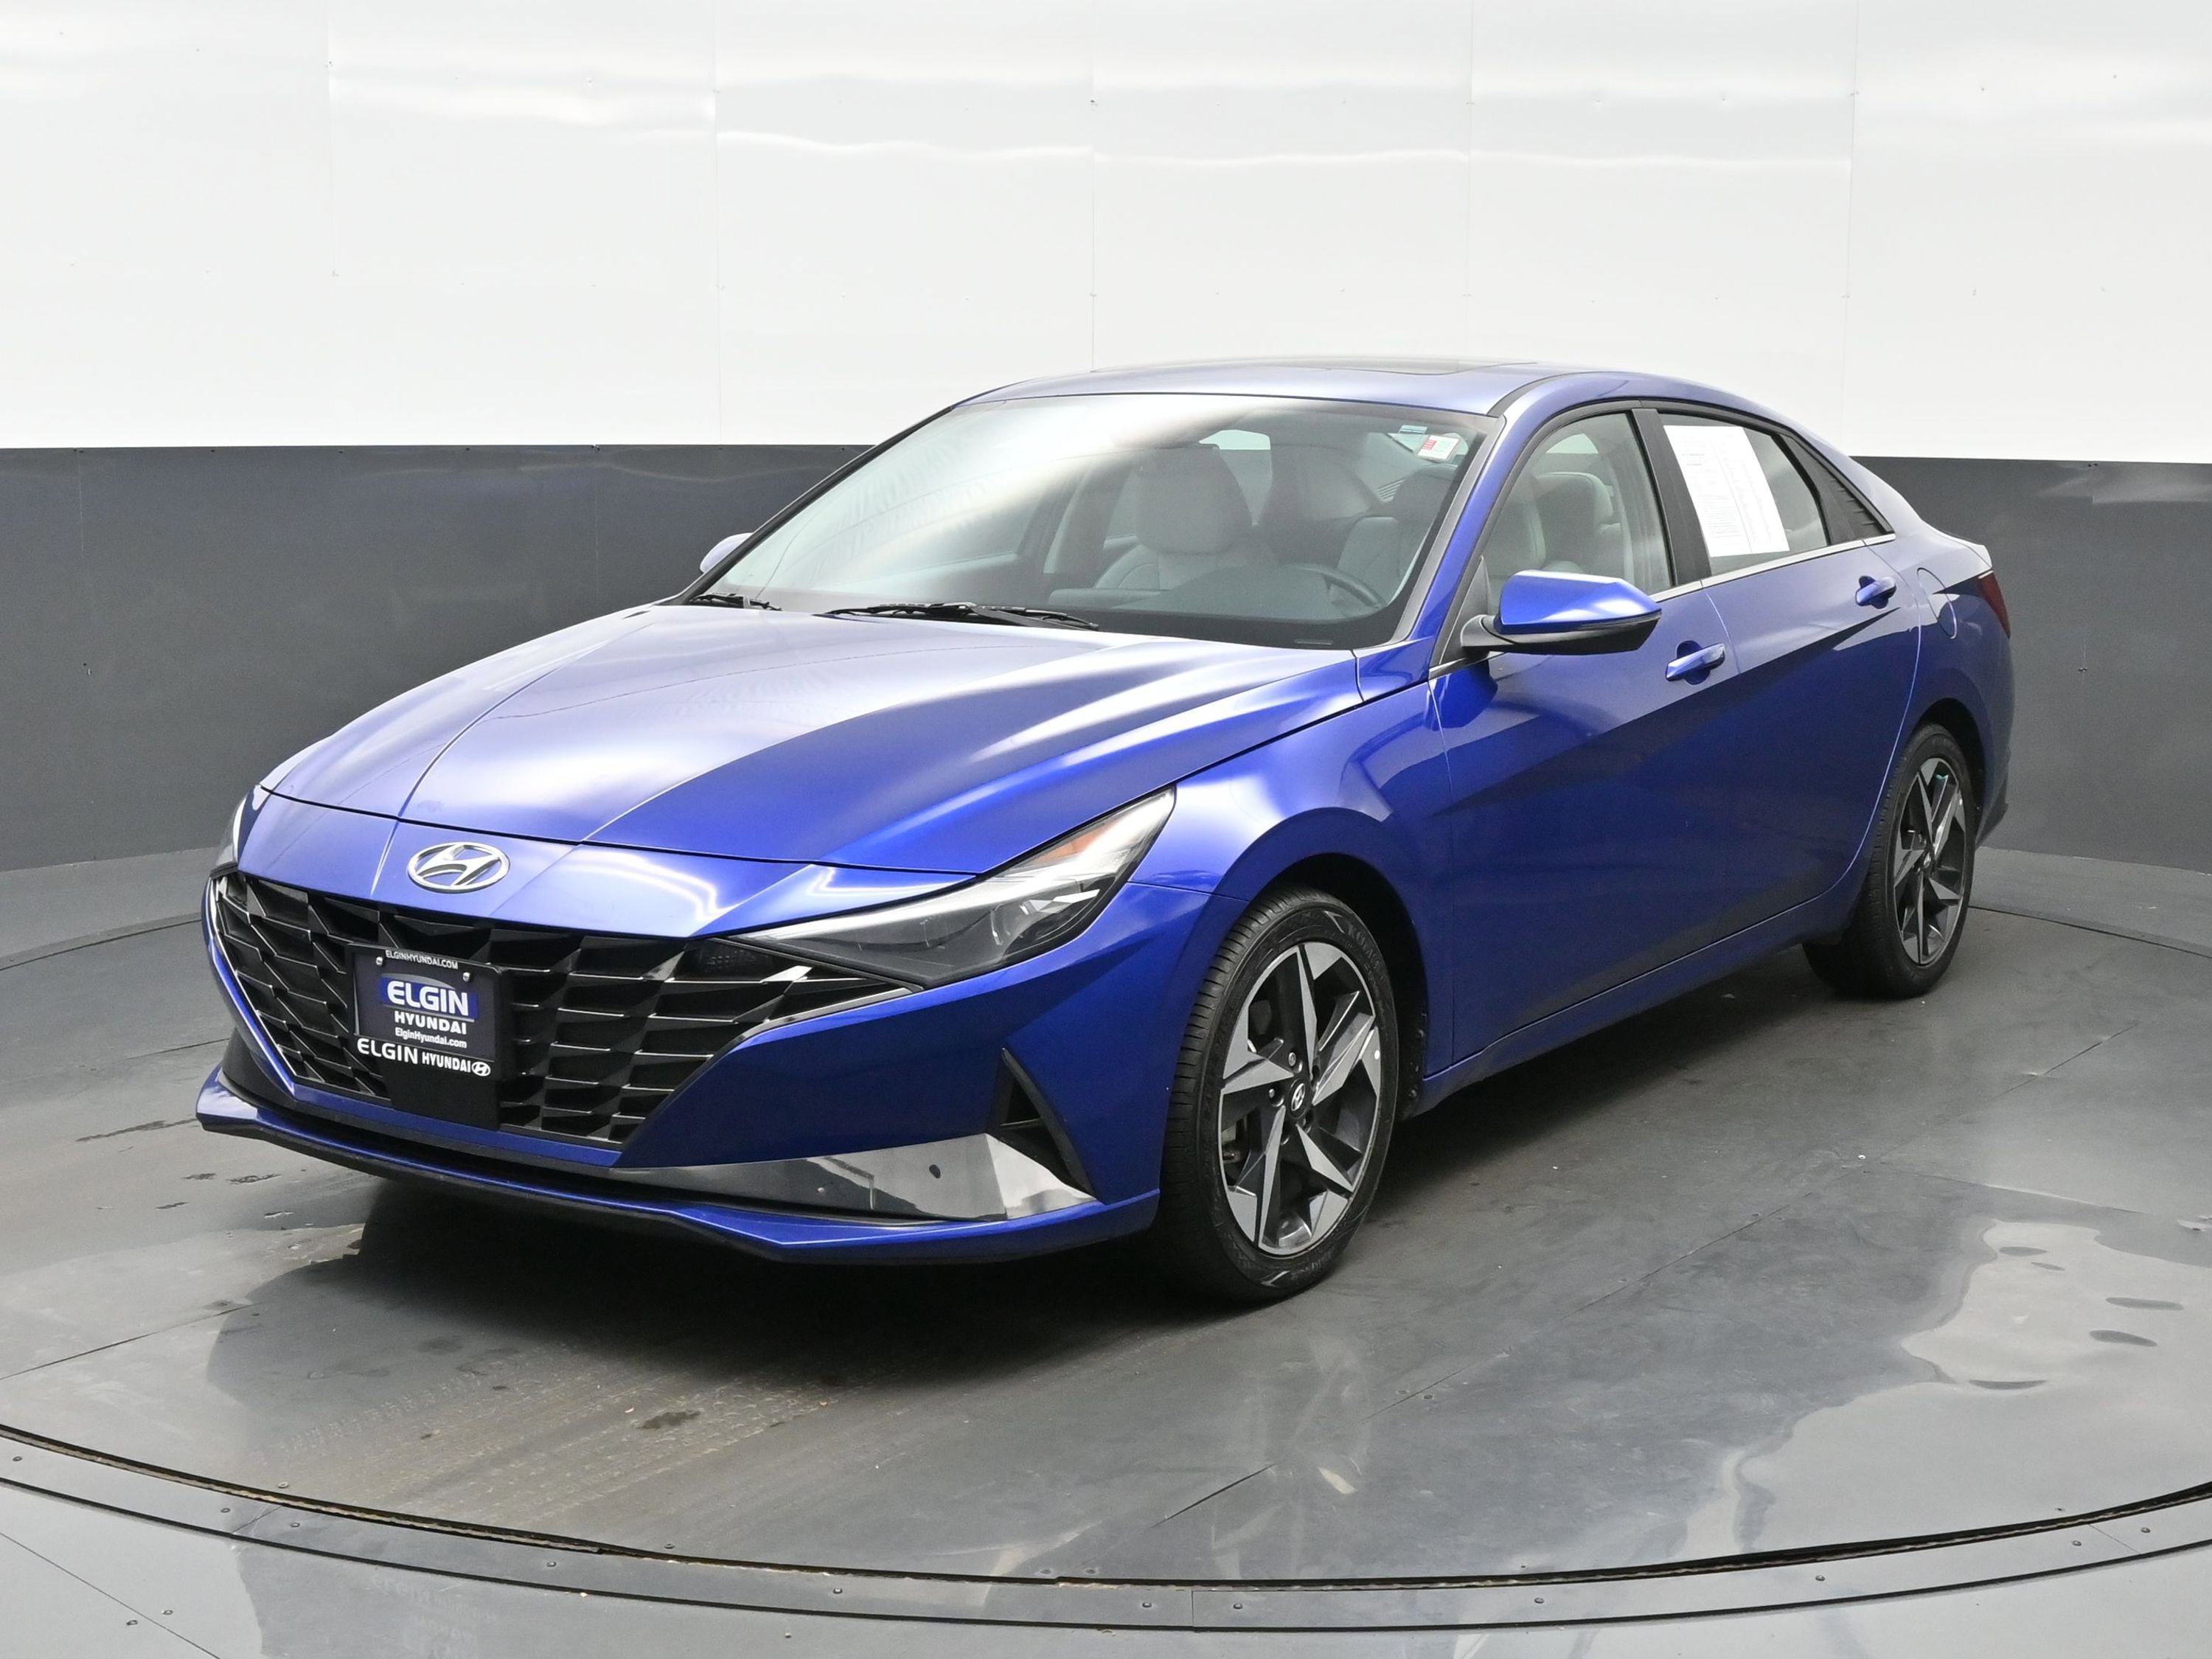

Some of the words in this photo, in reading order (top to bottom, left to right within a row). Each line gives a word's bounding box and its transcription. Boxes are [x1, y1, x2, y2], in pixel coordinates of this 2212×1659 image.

[385, 950, 459, 970] ELGINHYUNDAI.COM
[387, 981, 469, 1016] ELGIN
[394, 1011, 467, 1034] HYUNDAI
[394, 1027, 467, 1048] ElginHyundai.com
[357, 1037, 418, 1064] ELGIN
[422, 1051, 471, 1073] HYUNDAI
